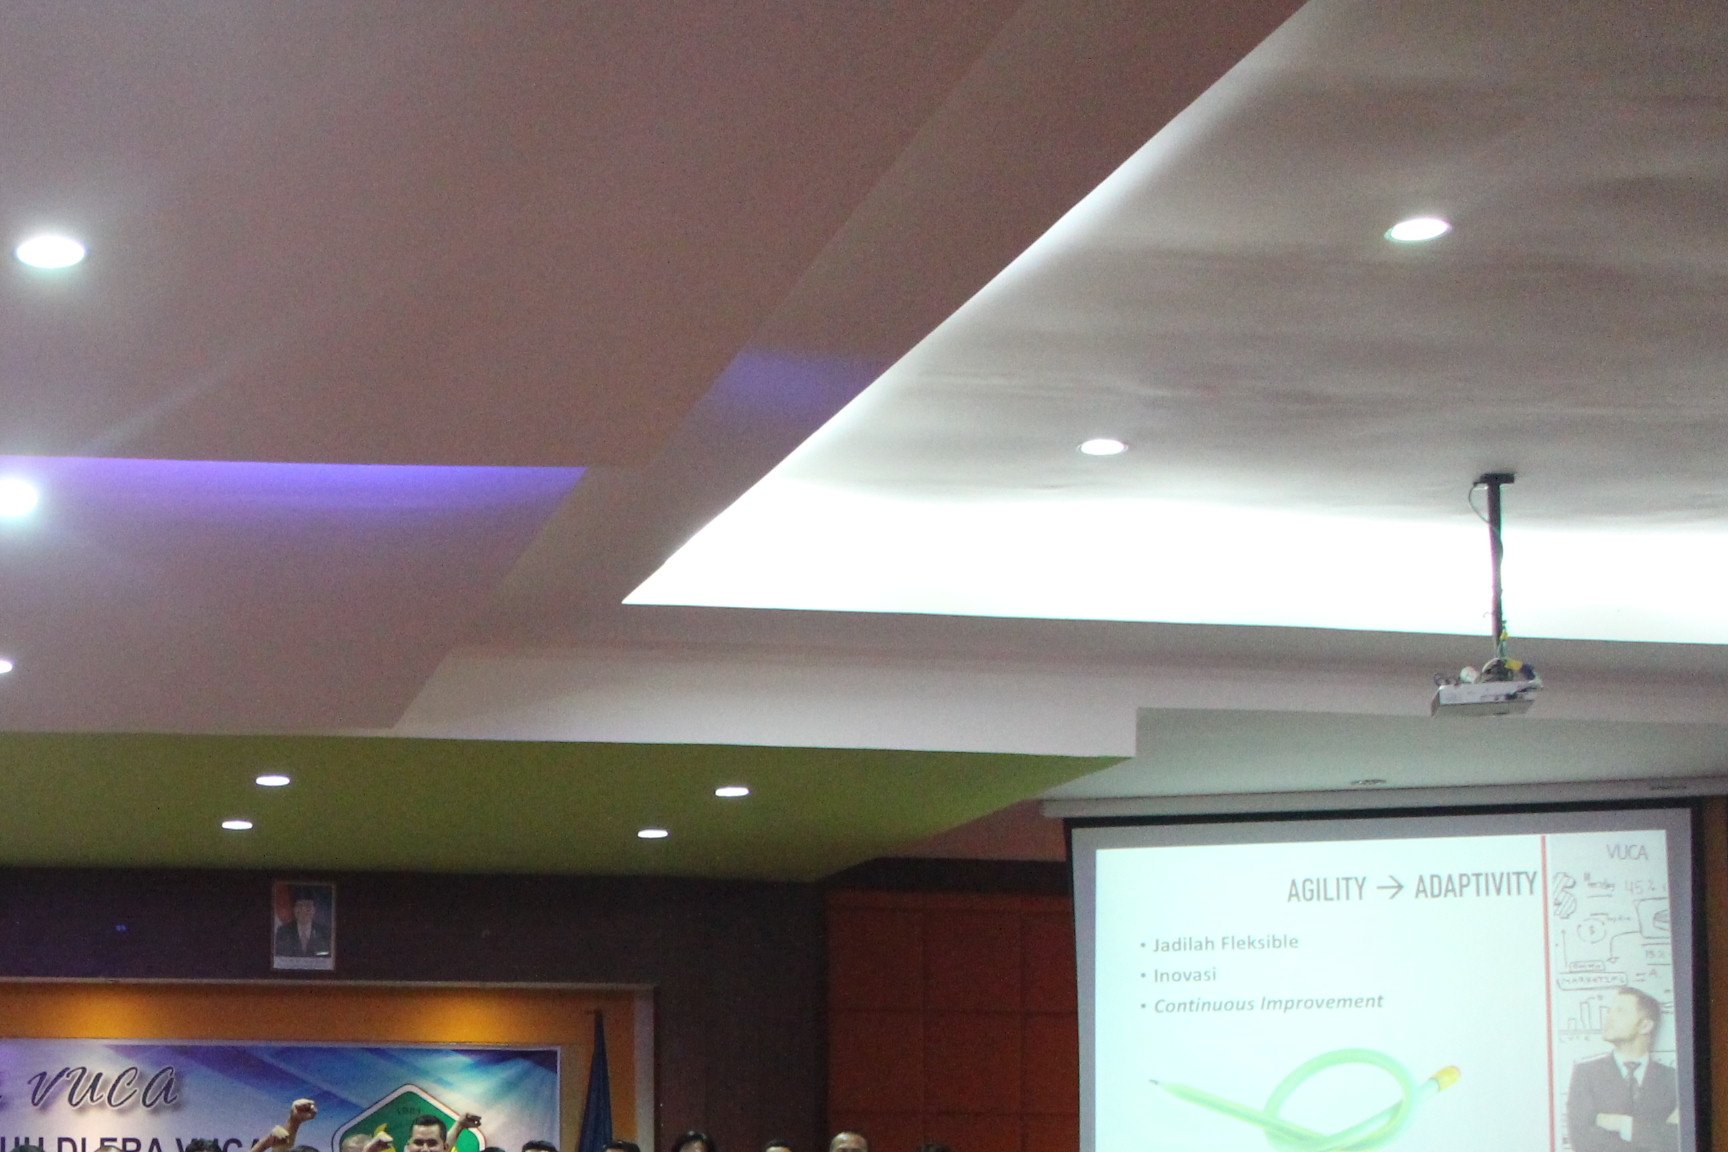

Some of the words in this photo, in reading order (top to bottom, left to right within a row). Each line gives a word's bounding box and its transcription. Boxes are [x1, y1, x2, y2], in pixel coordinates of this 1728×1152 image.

[1606, 844, 1649, 861] VUCA
[1287, 876, 1367, 902] AGILITY
[1414, 871, 1538, 898] ADAPTIVITY
[1153, 936, 1215, 953] Jadilah
[1221, 934, 1299, 951] Fleksible
[1154, 966, 1217, 983] Inovasi
[1154, 997, 1255, 1014] Continuous
[1260, 995, 1384, 1013] Improvement
[27, 1066, 178, 1107] VUCA
